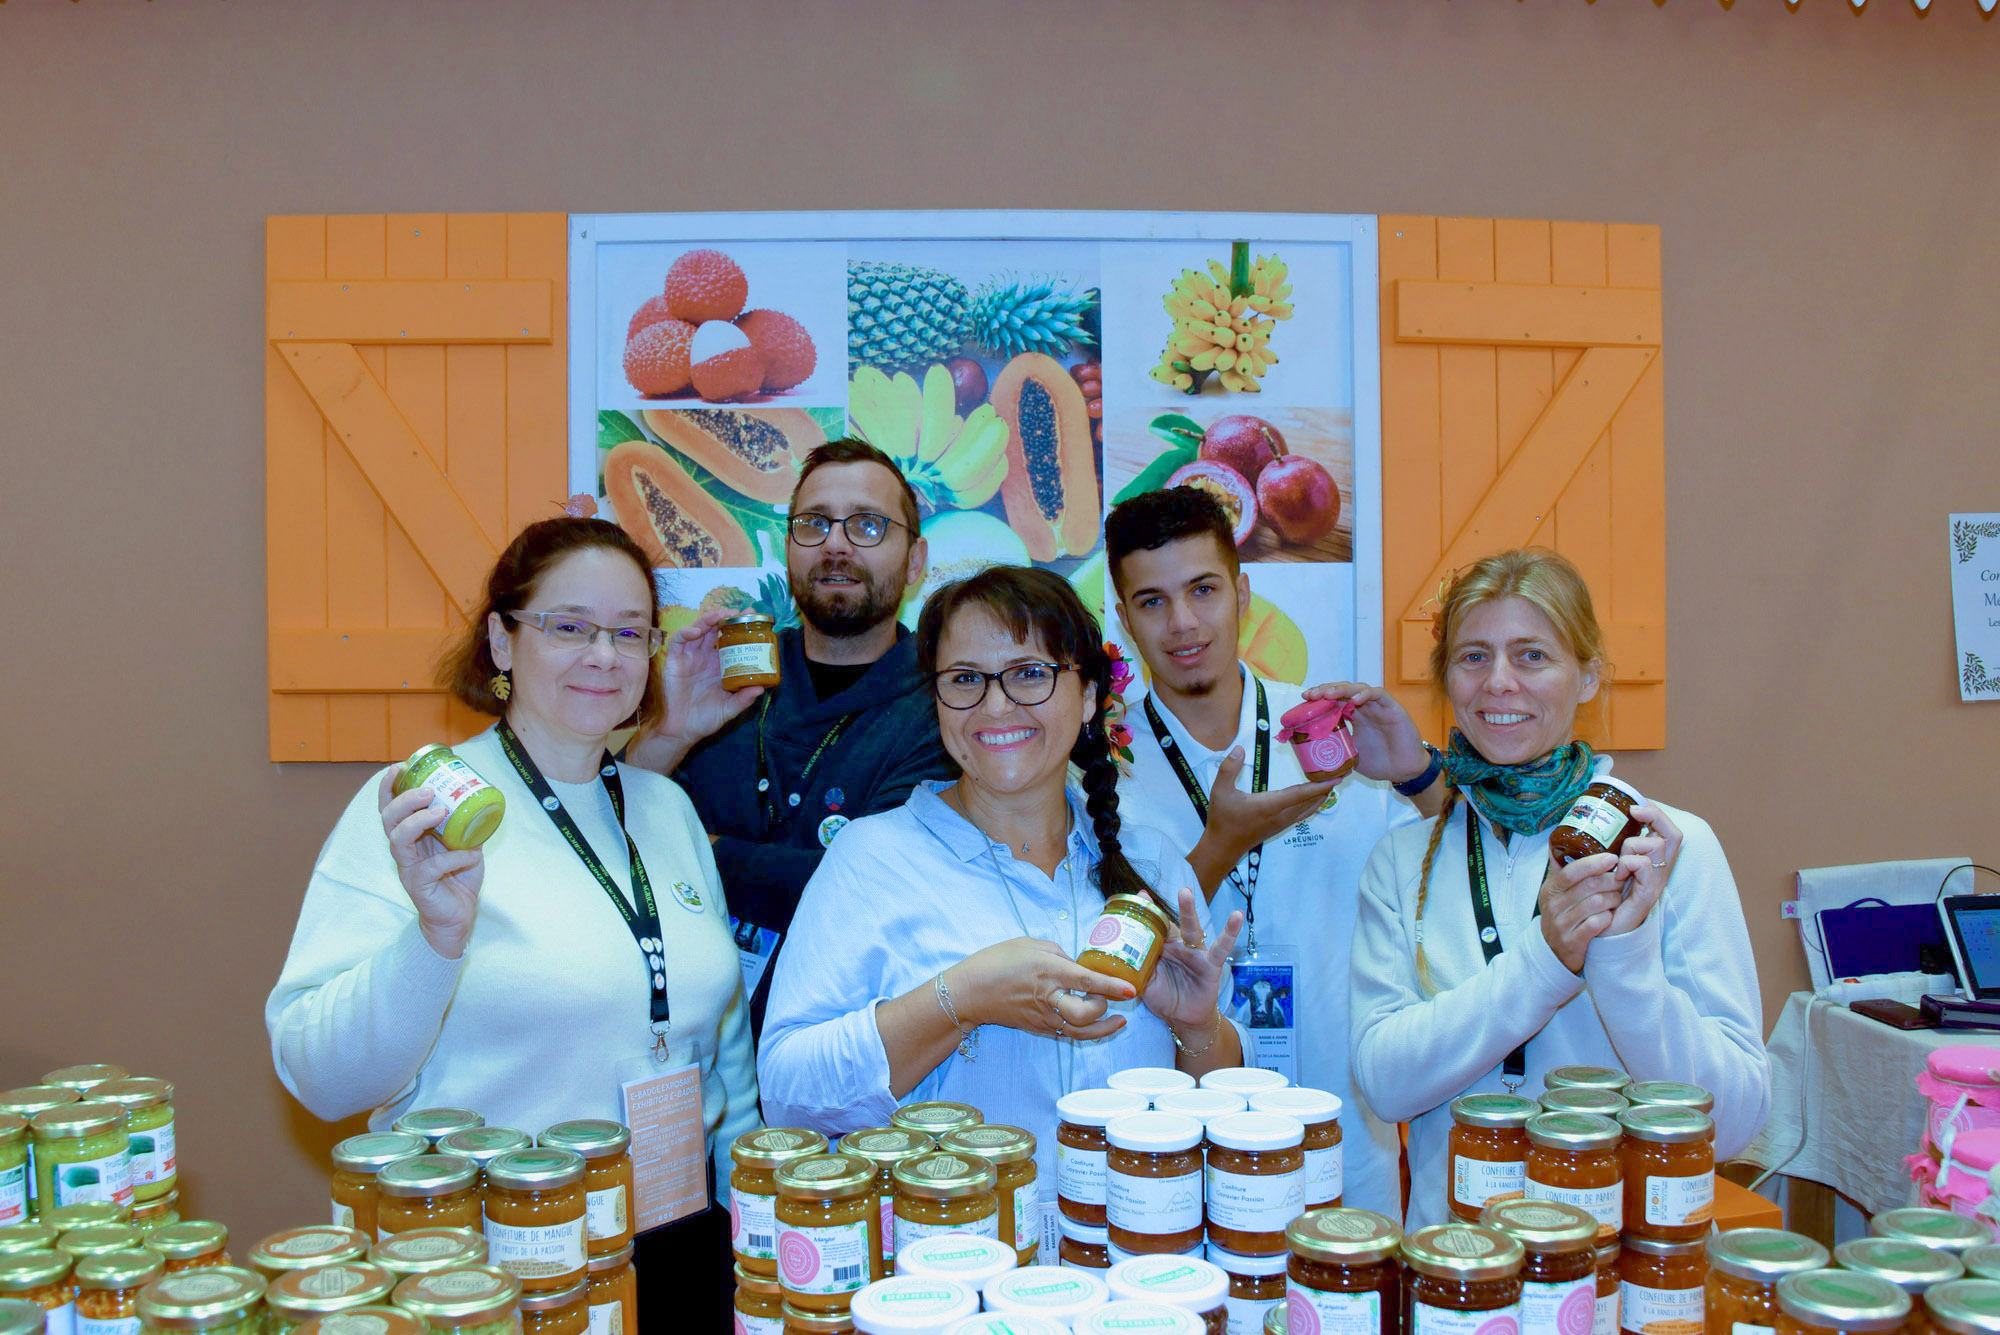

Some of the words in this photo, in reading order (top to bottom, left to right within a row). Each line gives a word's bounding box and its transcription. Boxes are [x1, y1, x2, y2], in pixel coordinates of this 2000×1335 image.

[559, 823, 587, 858] AGRICOLE
[581, 852, 608, 887] GÉNÉRAL
[1476, 874, 1491, 907] AGRICOLE
[603, 881, 633, 922] CONCOURS
[637, 882, 660, 919] AGRICOLE
[630, 1085, 661, 1101] E-BADGE
[661, 1075, 695, 1092] EXPOSANT
[631, 1093, 669, 1112] EXHIBITOR
[669, 1084, 700, 1101] E-BADGE
[1070, 1158, 1094, 1168] Confiture
[1065, 1165, 1089, 1176] Goyavier
[1481, 1165, 1516, 1176] CONFITURE
[1110, 1180, 1130, 1193] Confiture
[1221, 1182, 1247, 1192] Confiture
[1499, 1181, 1517, 1189] VANILLE
[1681, 1177, 1710, 1192] CONFITURE
[1125, 1196, 1147, 1205] Passion
[1216, 1189, 1240, 1201] Goyavier
[1241, 1195, 1265, 1203] Passion
[1544, 1190, 1581, 1205] CONFITURE
[1584, 1193, 1593, 1205] DE
[1595, 1190, 1616, 1202] PAPAYE
[492, 1225, 527, 1242] CONFITURE
[530, 1230, 540, 1242] DE
[544, 1225, 574, 1240] MANGUE
[813, 1236, 836, 1244] Mangue
[501, 1244, 519, 1256] FRUITS
[520, 1247, 528, 1257] DE
[530, 1246, 538, 1256] LA
[540, 1244, 565, 1255] PASSION
[1523, 1292, 1548, 1300] onfiture
[1639, 1290, 1676, 1304] CONFITURE
[1680, 1293, 1687, 1303] DE
[1648, 1307, 1655, 1315] LA
[1656, 1307, 1676, 1317] VANILLE
[1430, 1317, 1459, 1329] Confiture
